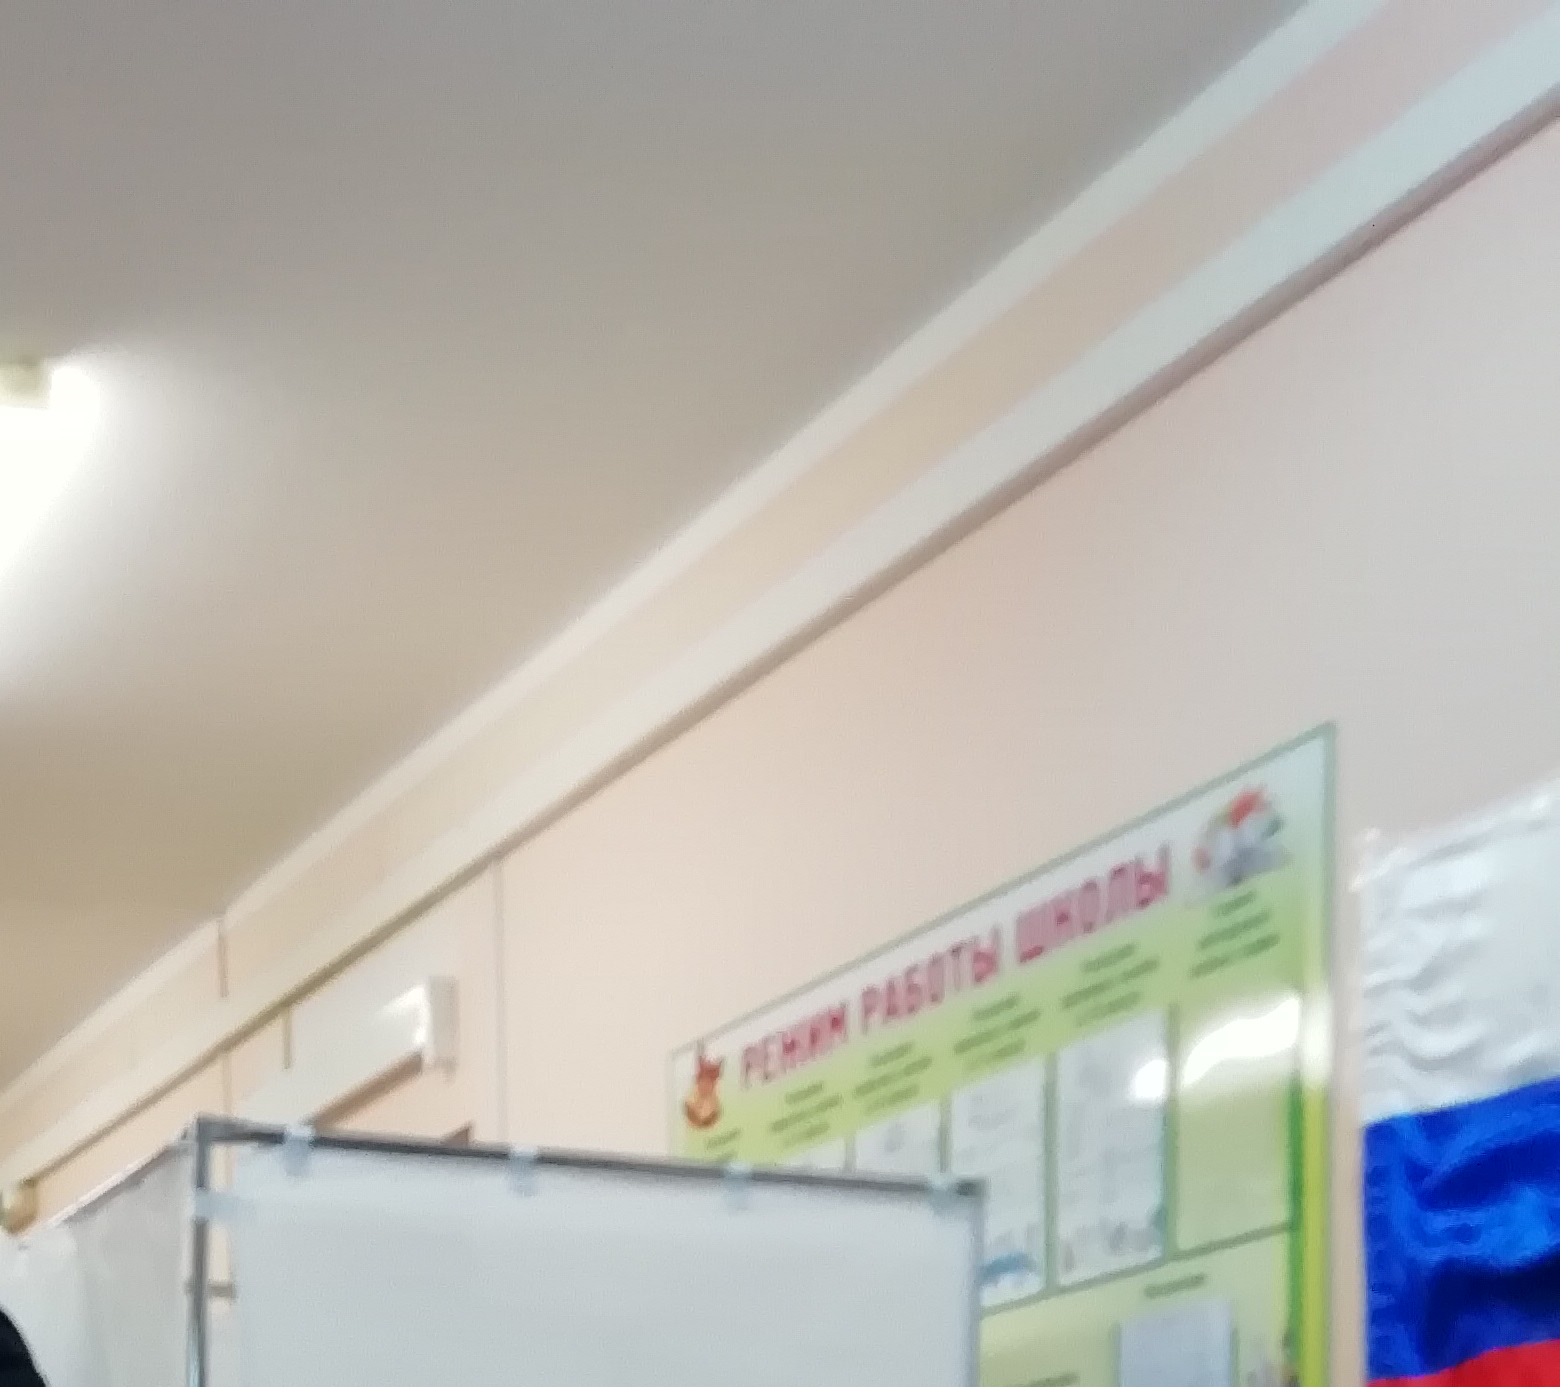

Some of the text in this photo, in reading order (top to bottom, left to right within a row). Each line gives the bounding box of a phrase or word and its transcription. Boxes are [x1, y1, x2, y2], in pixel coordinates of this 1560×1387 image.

[742, 1001, 849, 1088] РЕЖИМ
[861, 923, 1001, 1035] РАБОТЫ
[1015, 841, 1170, 965] ШКОЛЫ
